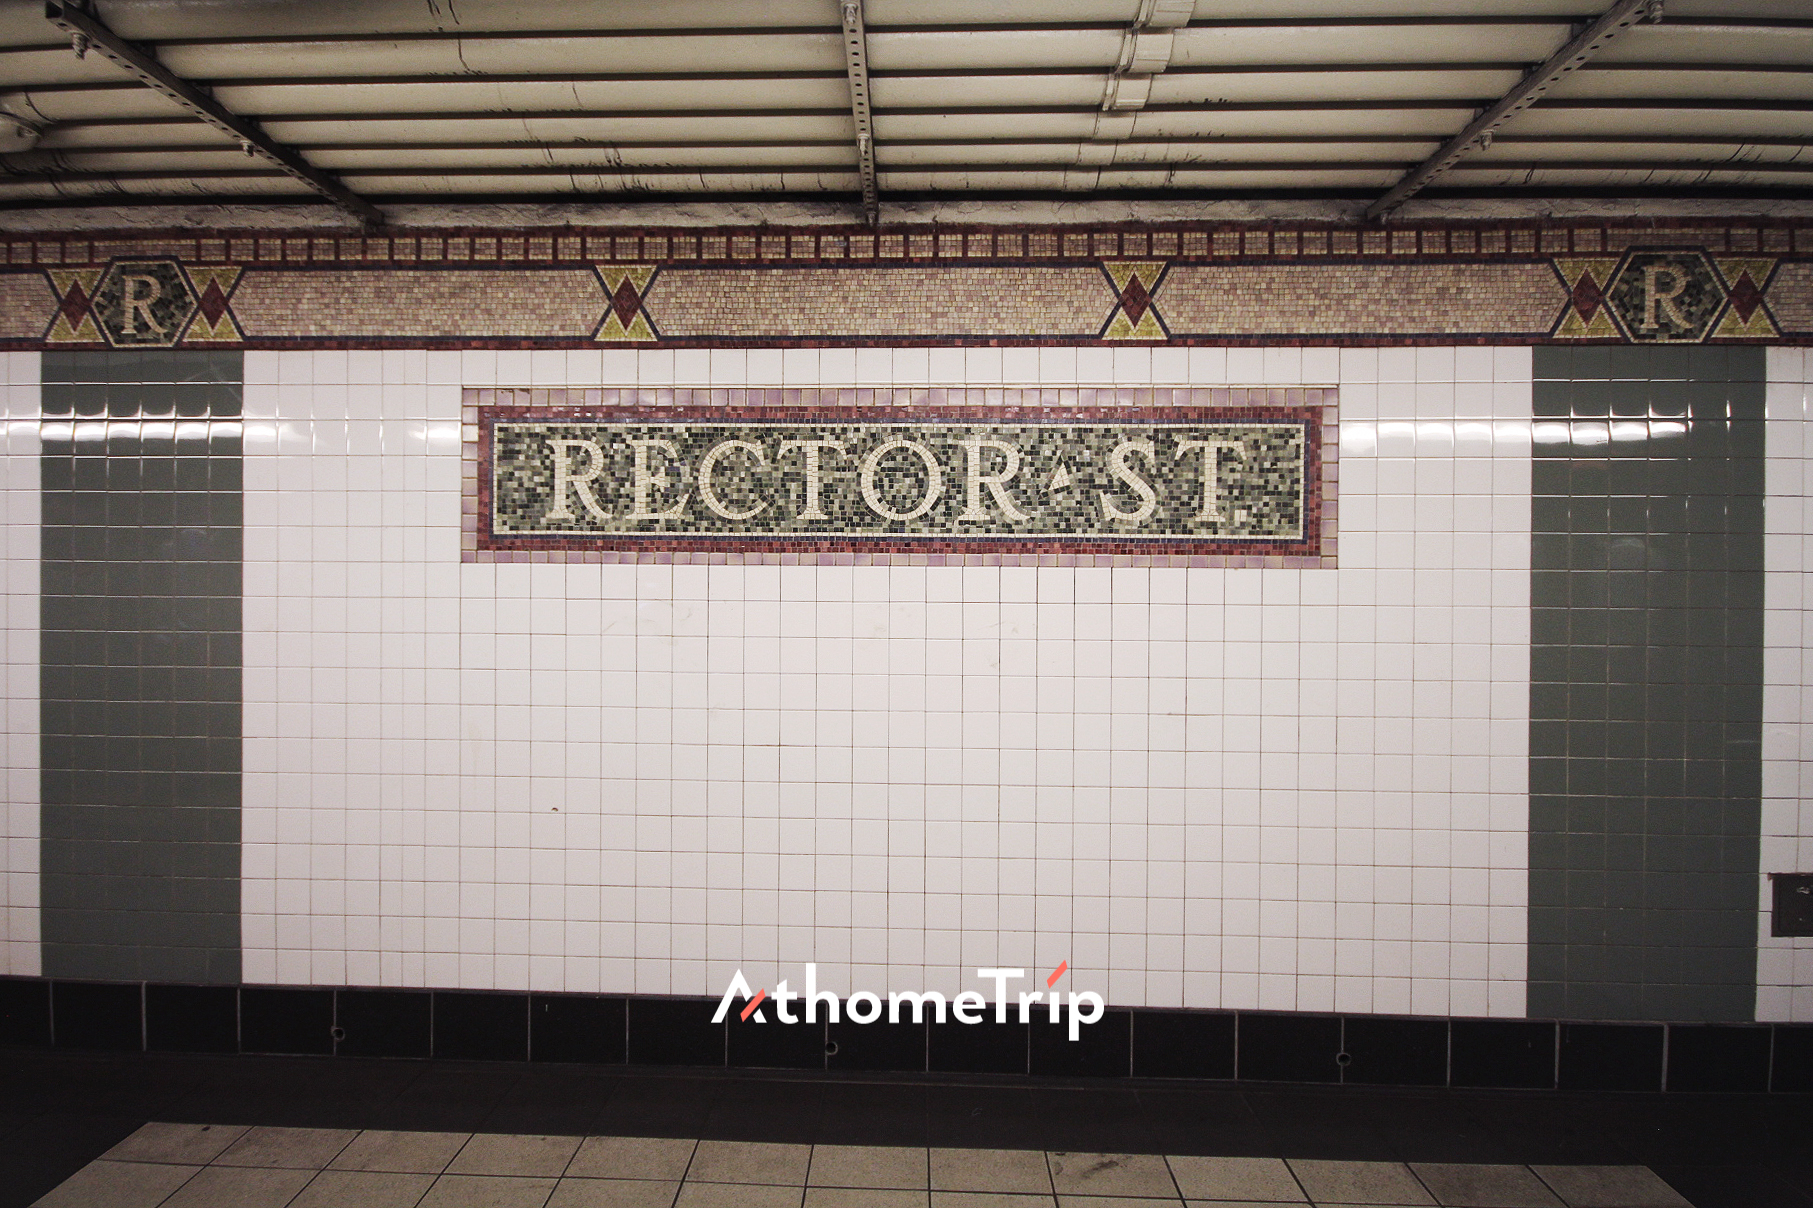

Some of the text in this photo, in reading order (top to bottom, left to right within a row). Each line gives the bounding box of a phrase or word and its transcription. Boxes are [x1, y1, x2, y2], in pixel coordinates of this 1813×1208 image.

[121, 274, 169, 334] R
[1640, 263, 1696, 329] R
[544, 437, 1037, 523] RECTOR
